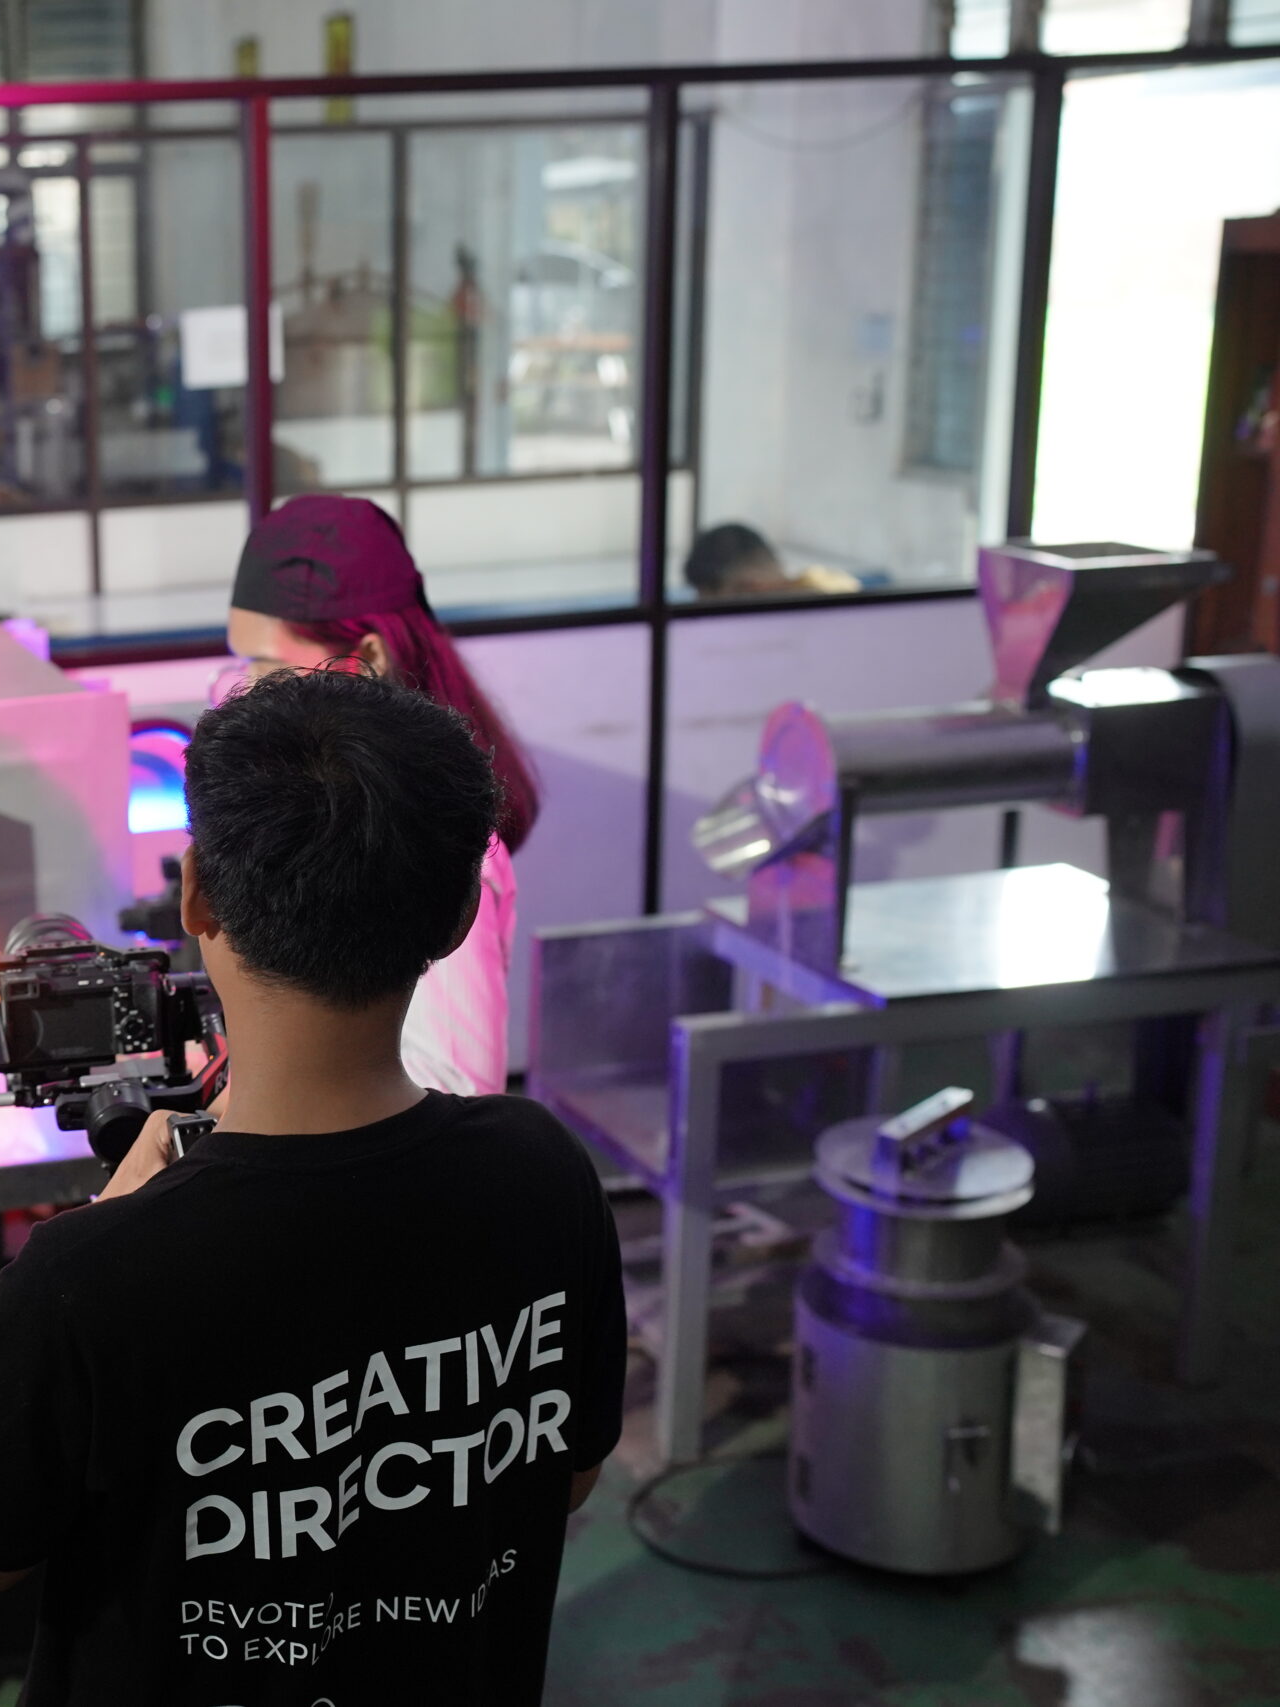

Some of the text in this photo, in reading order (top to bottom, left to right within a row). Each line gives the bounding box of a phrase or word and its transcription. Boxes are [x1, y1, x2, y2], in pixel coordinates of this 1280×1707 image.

[176, 1290, 566, 1477] CREATIVE
[185, 1389, 571, 1561] DIRECTOR
[179, 1548, 517, 1666] TO EXPLORE NEW IDAS
